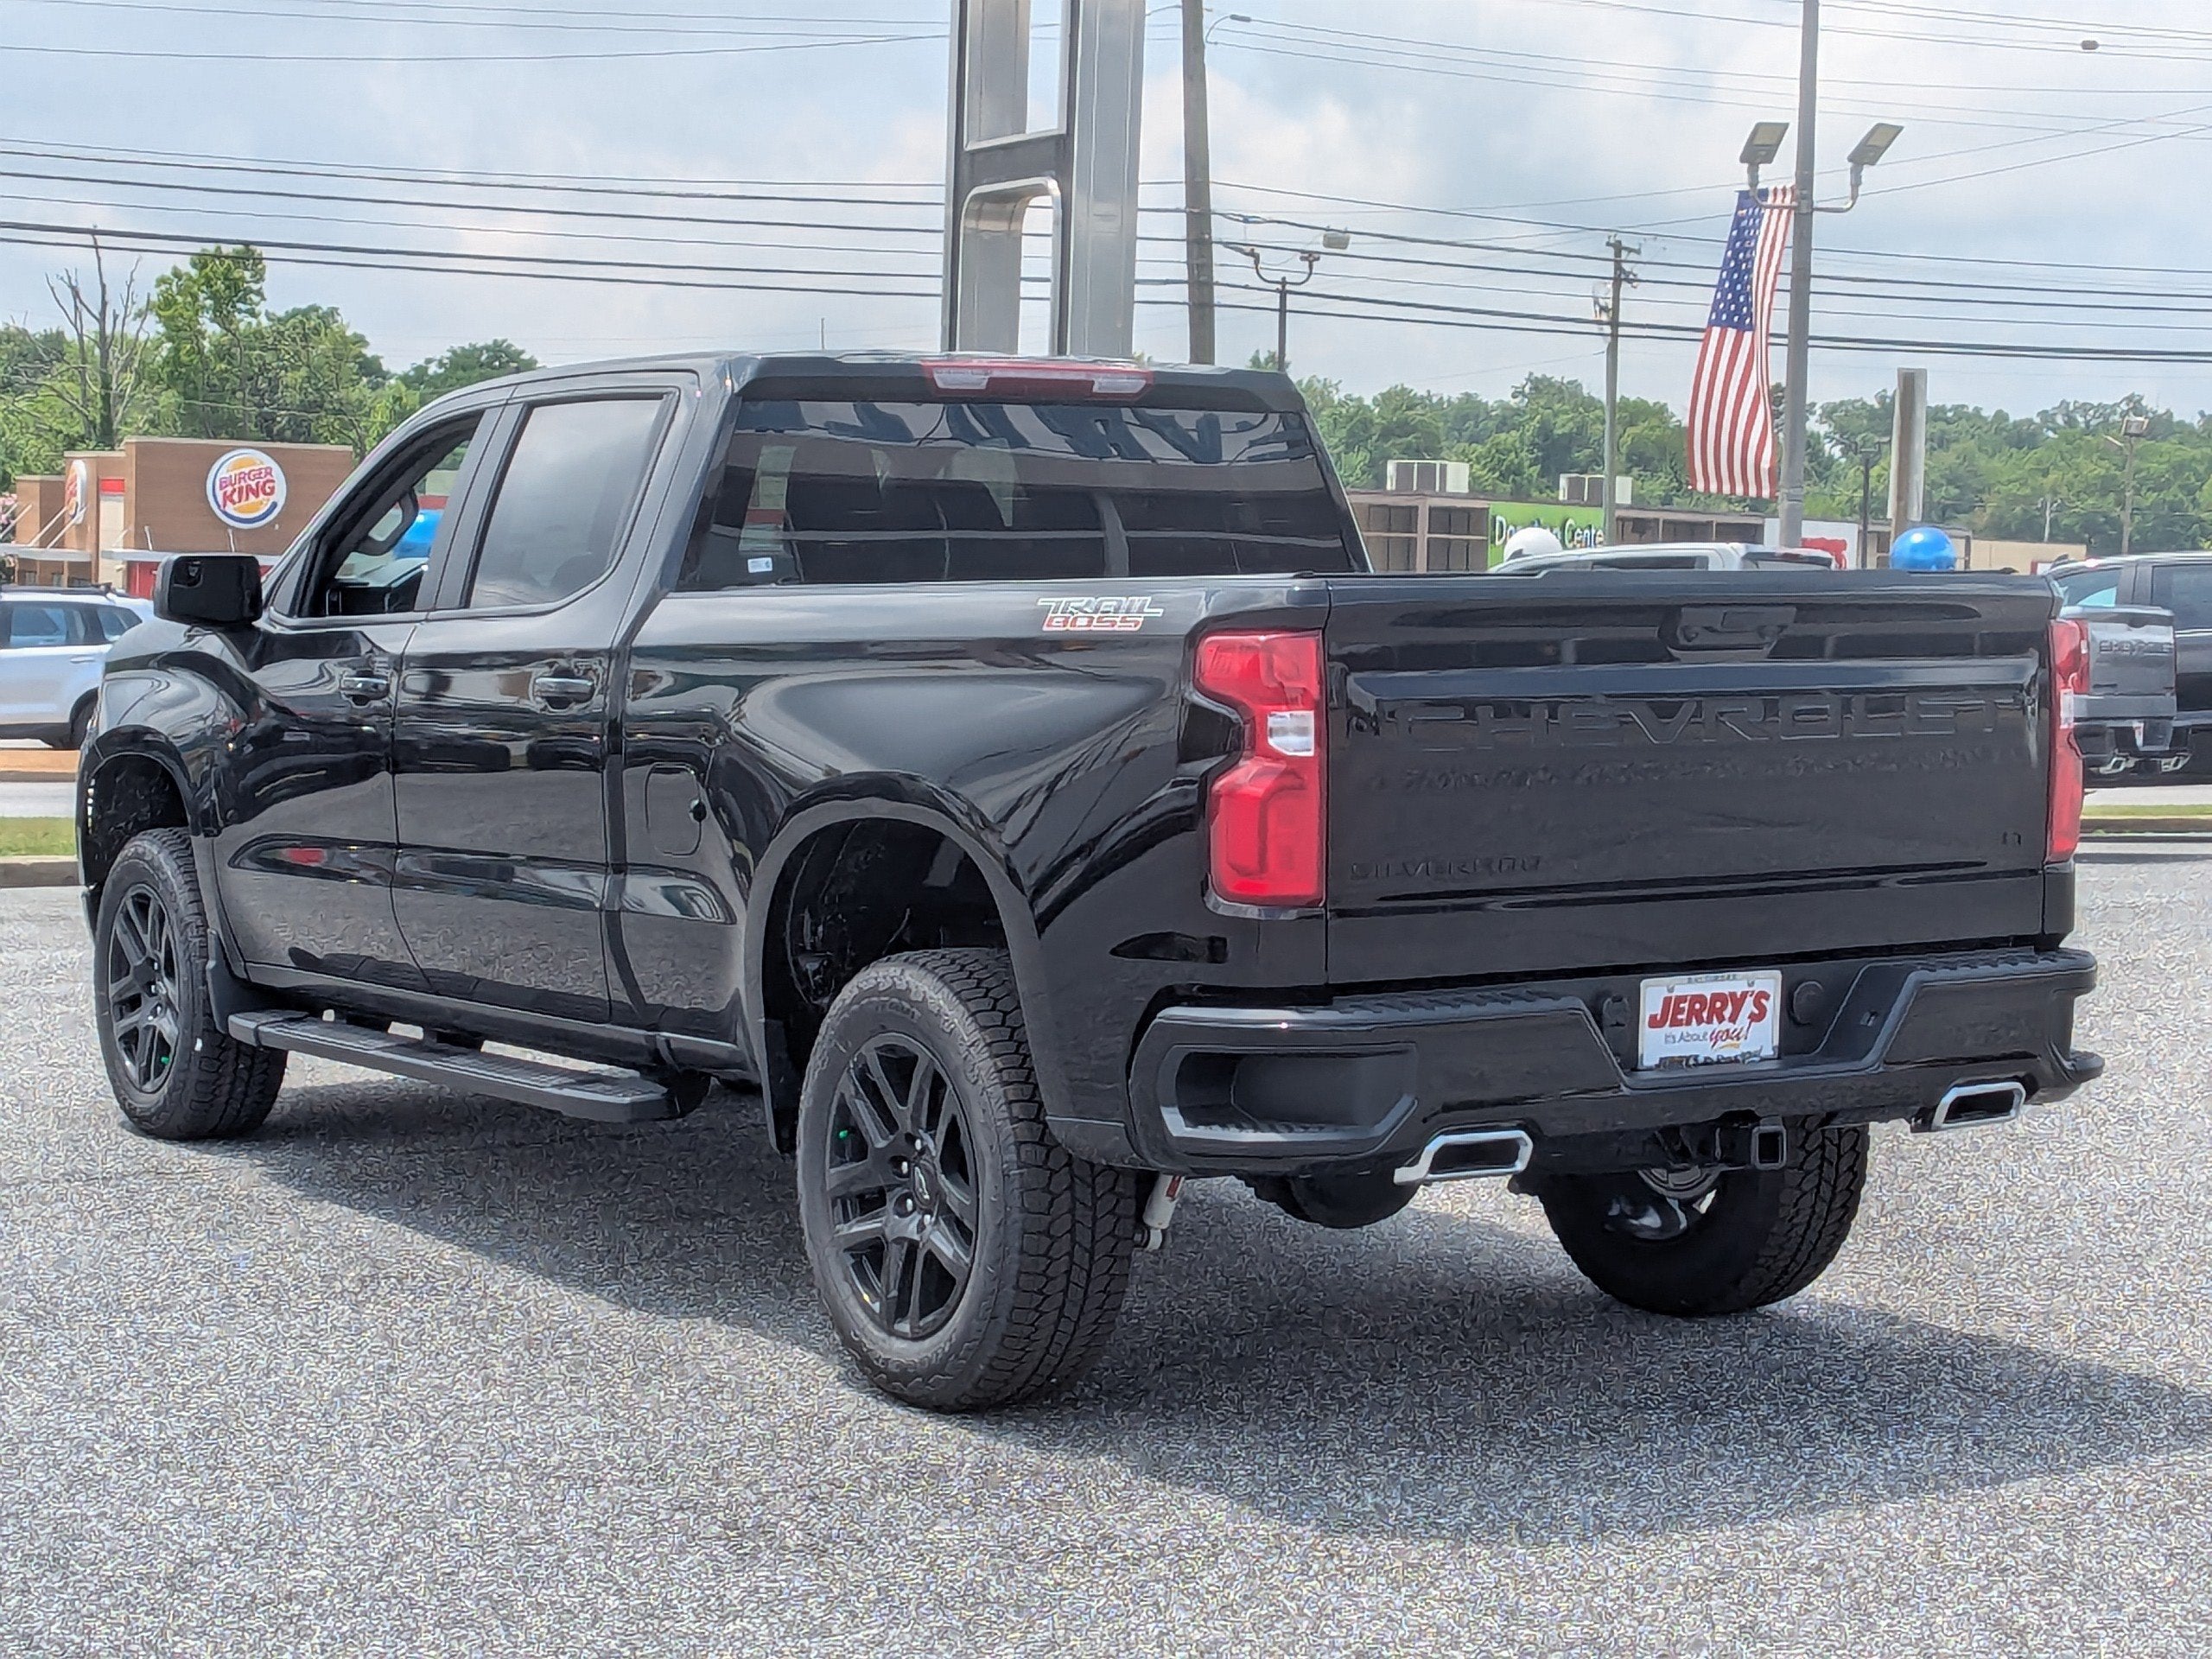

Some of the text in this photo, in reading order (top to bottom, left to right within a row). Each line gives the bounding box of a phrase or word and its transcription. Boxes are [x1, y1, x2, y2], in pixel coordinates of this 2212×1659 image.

[219, 466, 273, 491] BURGER
[222, 479, 276, 510] KING
[1564, 518, 1605, 548] Cente
[1037, 596, 1164, 617] TRAIL
[1042, 614, 1145, 632] BOSS
[1391, 691, 2012, 751] CHEVROLET
[1648, 989, 1771, 1029] JERRY'S
